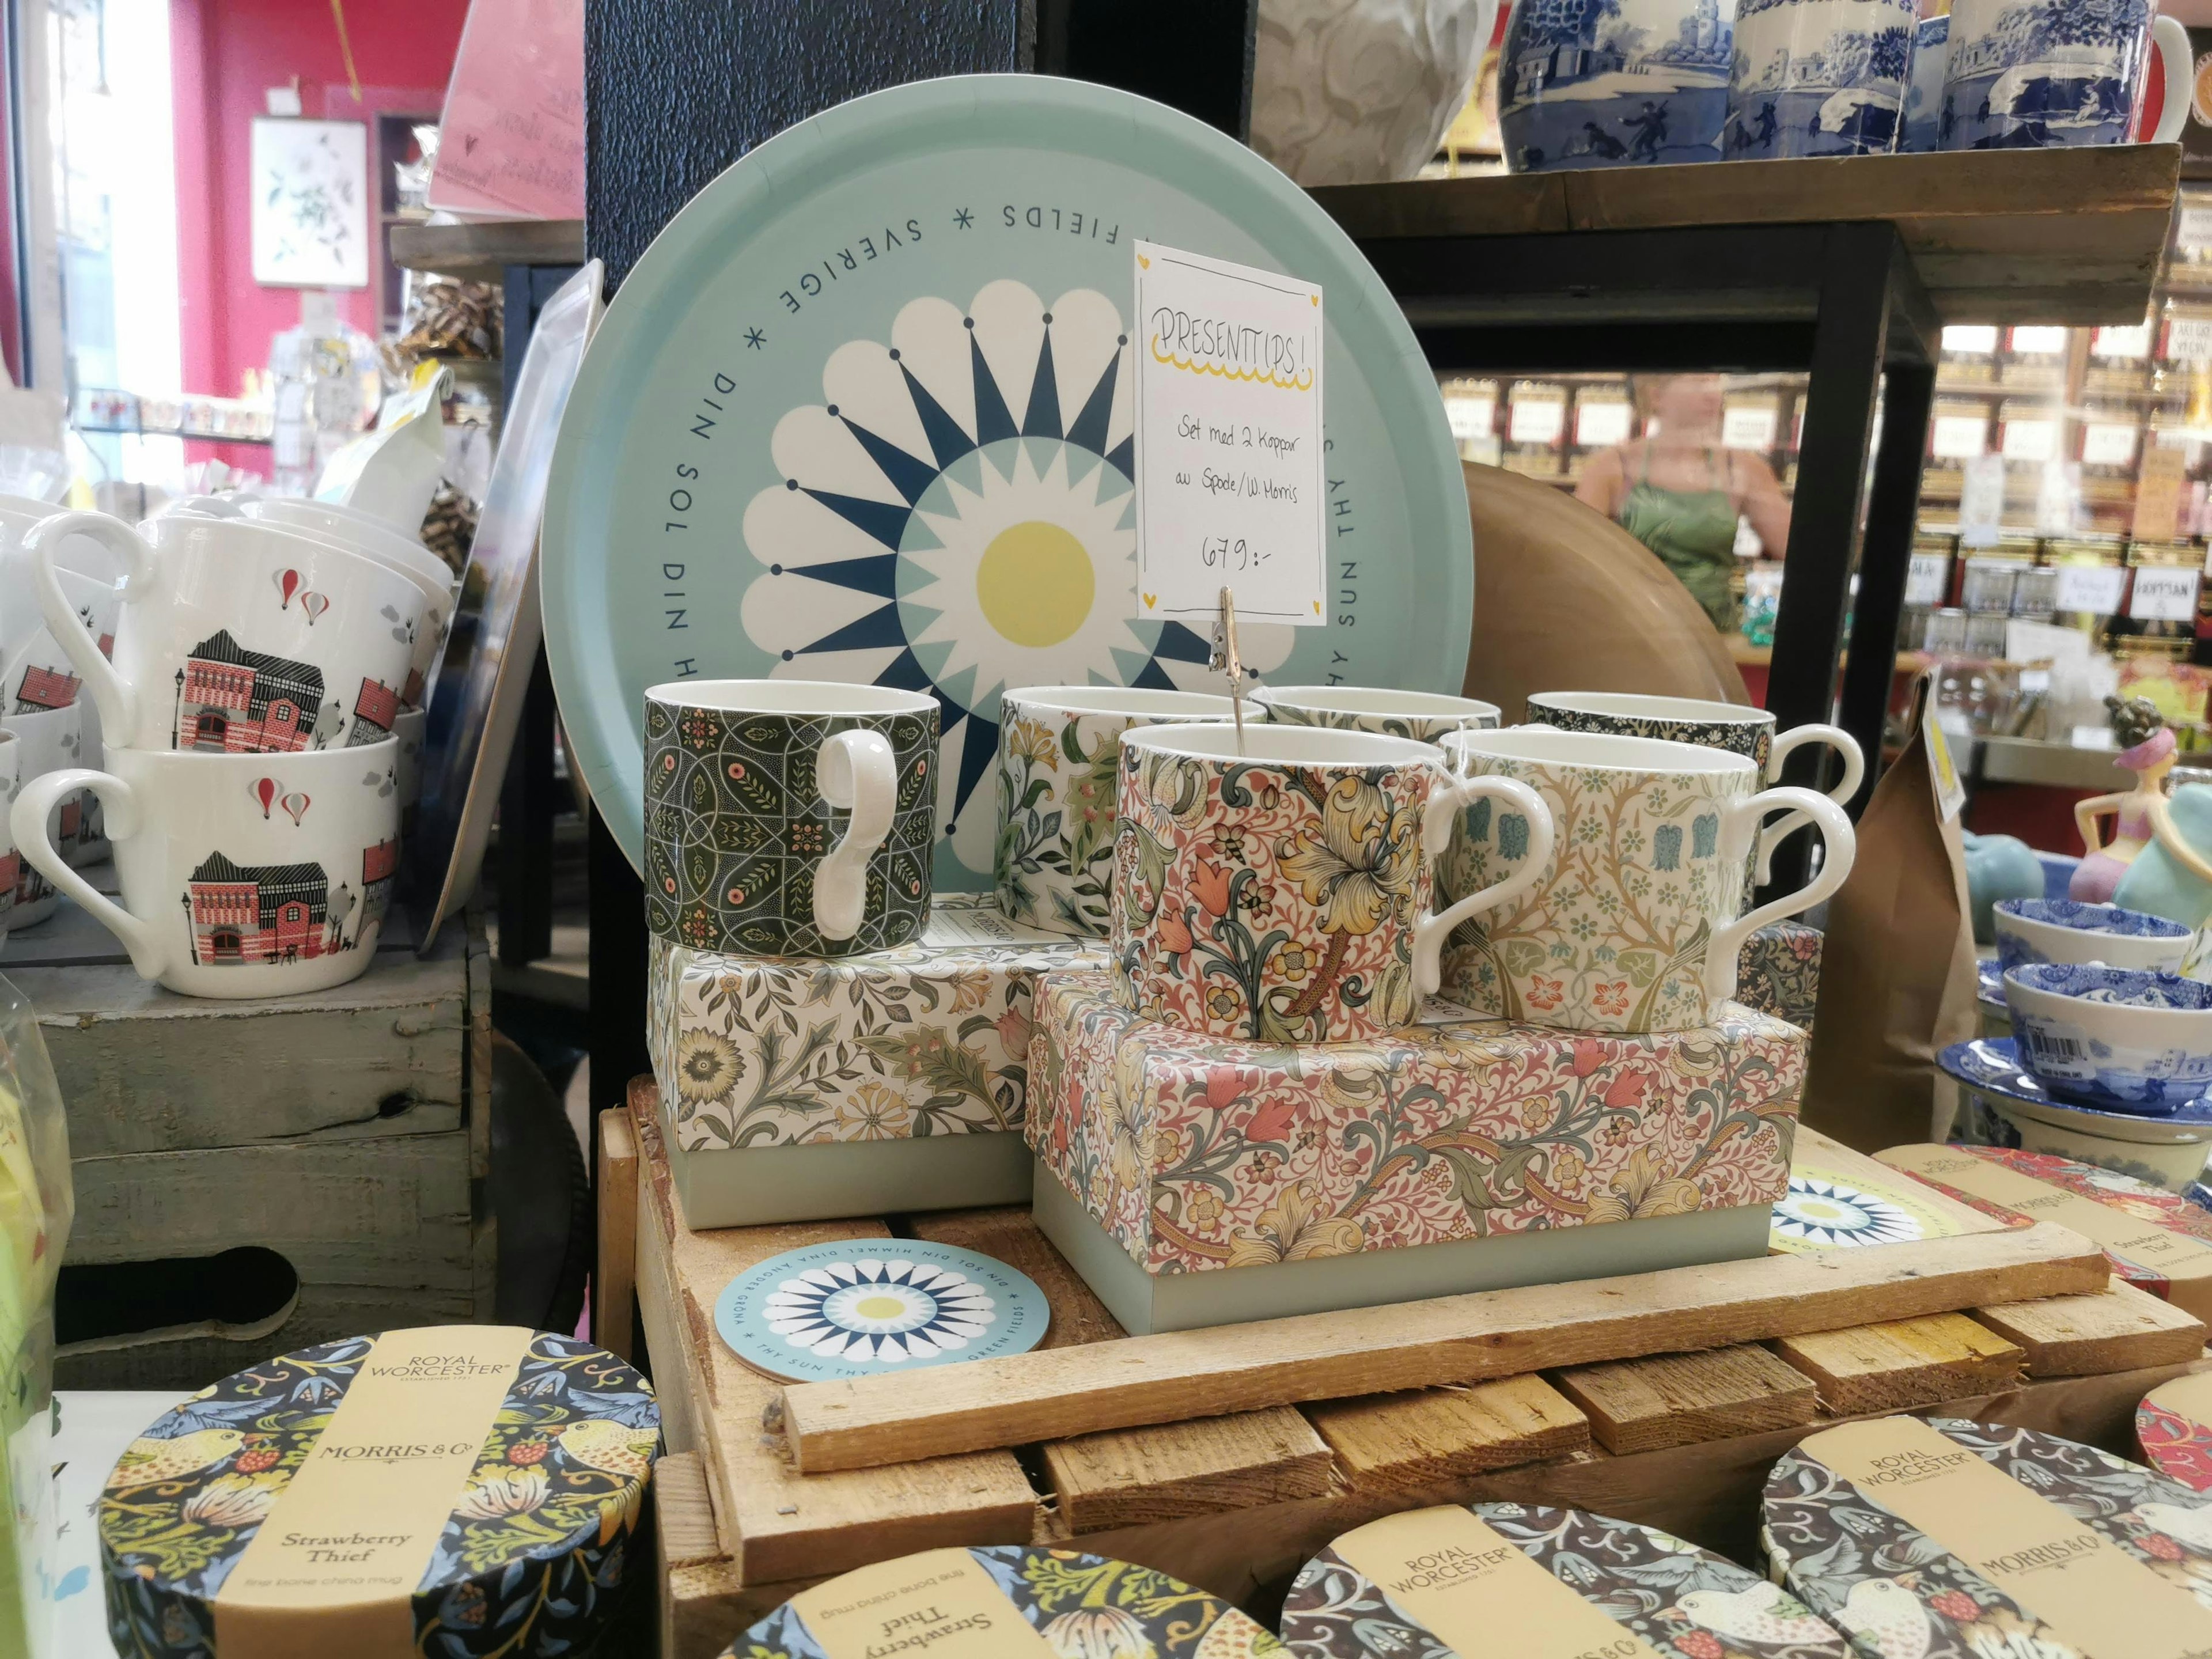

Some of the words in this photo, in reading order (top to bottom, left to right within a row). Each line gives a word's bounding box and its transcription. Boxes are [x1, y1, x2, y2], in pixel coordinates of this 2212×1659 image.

[1003, 205, 1118, 244] FIELDS
[779, 219, 922, 313] SVERIGE
[690, 373, 736, 439] DIN
[1178, 414, 1200, 440] Set
[1210, 425, 1234, 446] med
[1243, 426, 1253, 447] 2
[665, 463, 699, 532] SOL
[1328, 479, 1354, 537] THY
[663, 563, 688, 630] DIN
[1338, 562, 1357, 627] SUN
[1325, 650, 1349, 686] HY
[798, 1250, 838, 1262] DINA
[922, 1250, 950, 1260] DIN
[959, 1259, 984, 1272] SOL
[968, 1336, 1009, 1361] GREEN
[1007, 1305, 1024, 1334] FIELDS
[408, 1355, 478, 1366] ROYAL
[756, 1343, 783, 1358] THY
[788, 1358, 823, 1372] SUN
[319, 1445, 432, 1459] MORRIS
[432, 1444, 446, 1455] &
[1869, 1449, 1934, 1470] ROYAL
[281, 1532, 413, 1547] Strawberry
[306, 1549, 376, 1563] Thief
[1404, 1546, 1474, 1573] ROYAL
[1980, 1543, 2071, 1577] MORRIS
[900, 1576, 938, 1594] bone
[938, 1569, 965, 1578] fine
[857, 1590, 897, 1608] china
[865, 1613, 993, 1659] Strawberry
[880, 1606, 950, 1637] Thief
